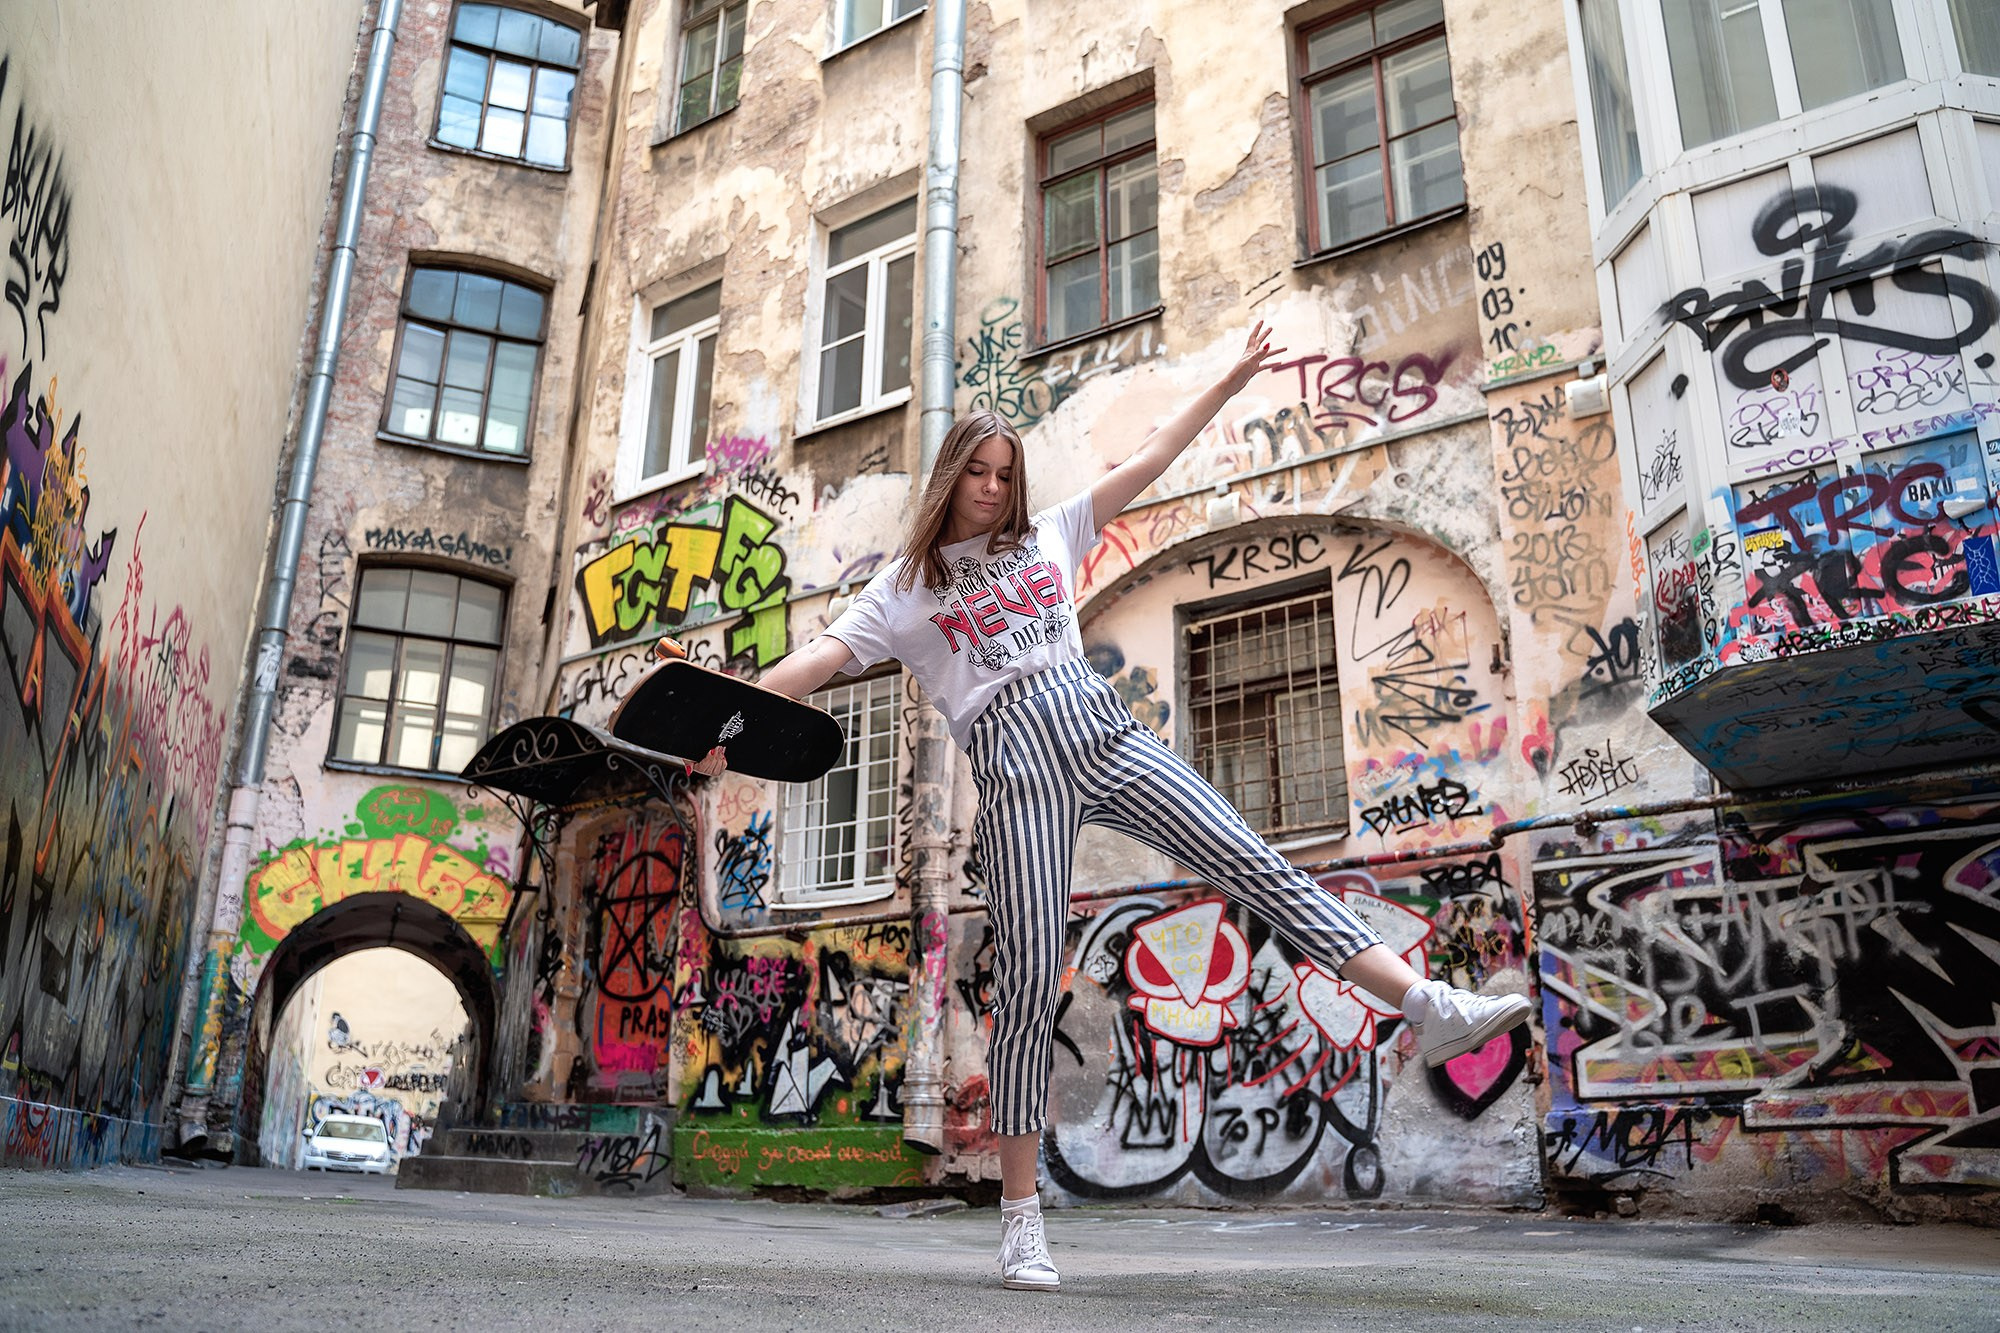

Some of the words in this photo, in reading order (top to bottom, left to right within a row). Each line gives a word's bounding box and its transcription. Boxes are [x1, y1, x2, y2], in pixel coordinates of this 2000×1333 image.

[1907, 478, 1954, 502] BAKU
[956, 571, 990, 598] ROCK
[1011, 620, 1043, 651] DIE
[1150, 920, 1202, 954] ЧТО
[1171, 953, 1203, 976] СО
[619, 1006, 671, 1042] PRAY
[1151, 1002, 1211, 1031] МНОЙ
